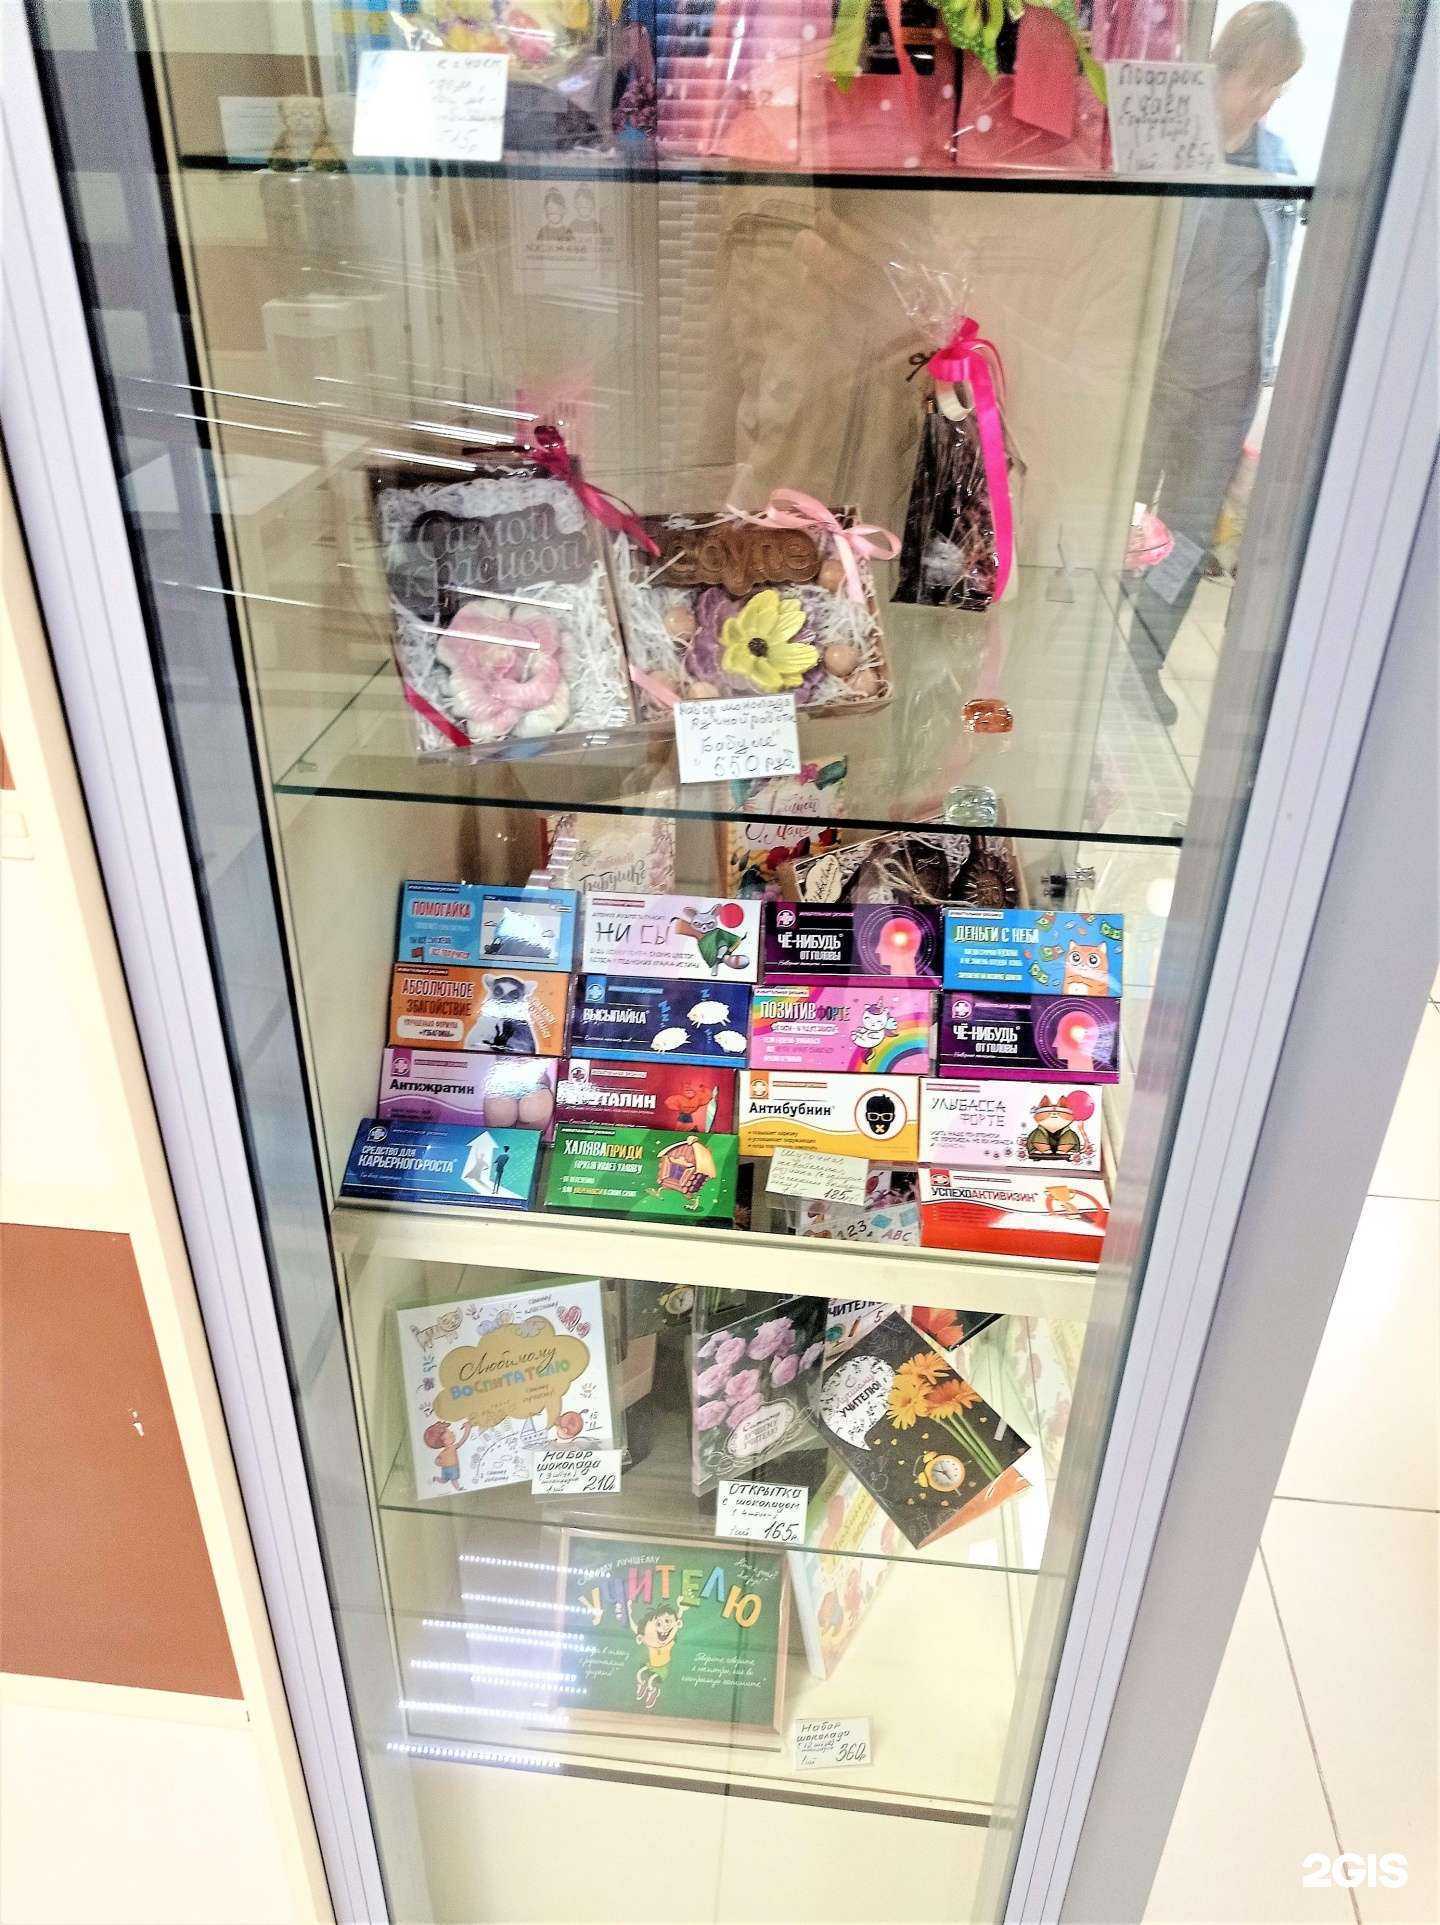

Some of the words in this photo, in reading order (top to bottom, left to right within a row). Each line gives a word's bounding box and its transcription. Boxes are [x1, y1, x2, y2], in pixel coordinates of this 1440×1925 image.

[411, 899, 472, 919] ПОМОГАЙКА
[595, 921, 632, 943] НИ
[640, 925, 671, 945] СЫ
[777, 931, 841, 950] ЧЁ-НИБУДЬ
[954, 925, 999, 943] ДЕНЬГИ
[1001, 927, 1010, 943] С
[1012, 928, 1040, 944] НЕБА
[400, 978, 474, 998] АБСОЛЮТНОЕ
[406, 999, 472, 1017] ЗБАГОЙСТВИЕ
[582, 1006, 647, 1025] ВЫСЫПАЙКА
[953, 1024, 1018, 1043] ЧЁ-НИБУДЬ
[389, 1079, 474, 1095] Антижратин
[749, 1102, 832, 1117] Антибубнин
[931, 1097, 1006, 1113] УЛЫБАССА
[361, 1145, 398, 1157] СРЕДСТВО
[399, 1147, 416, 1158] ДЛЯ
[451, 1359, 570, 1400] ВОСПИТАТЕЛЮ
[578, 1565, 763, 1628] УЧИТЕЛЮ
